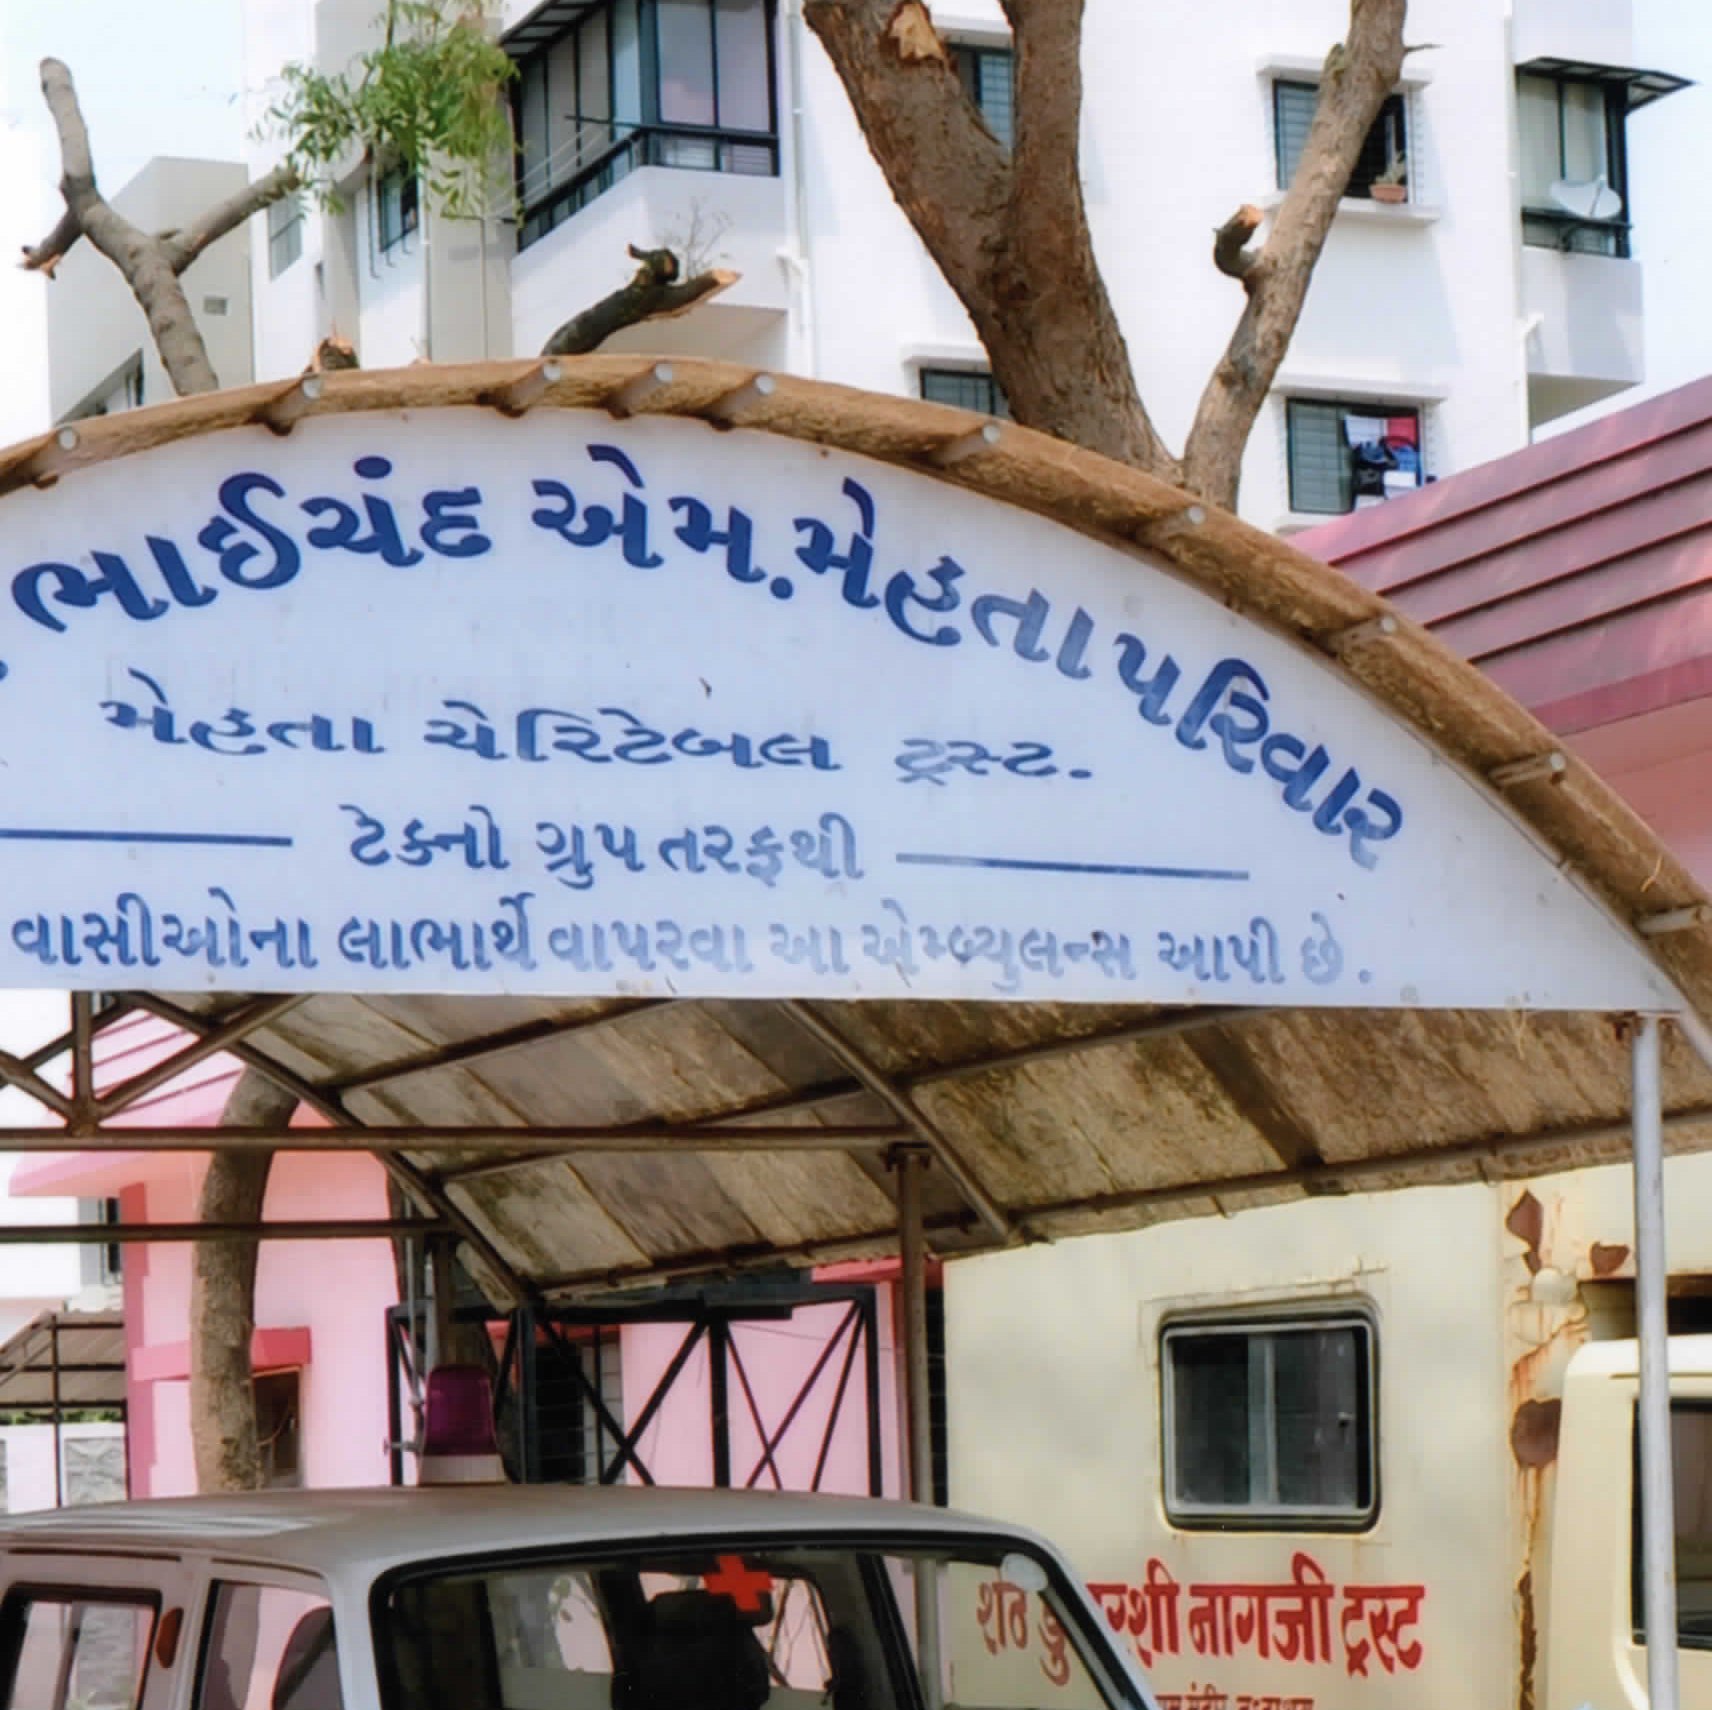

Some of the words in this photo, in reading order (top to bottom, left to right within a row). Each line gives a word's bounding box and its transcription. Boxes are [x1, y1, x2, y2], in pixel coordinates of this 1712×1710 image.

[11, 456, 491, 632] ભાઈચંદ
[100, 668, 386, 756] મેહતા
[1187, 1551, 1335, 1665] नागजी
